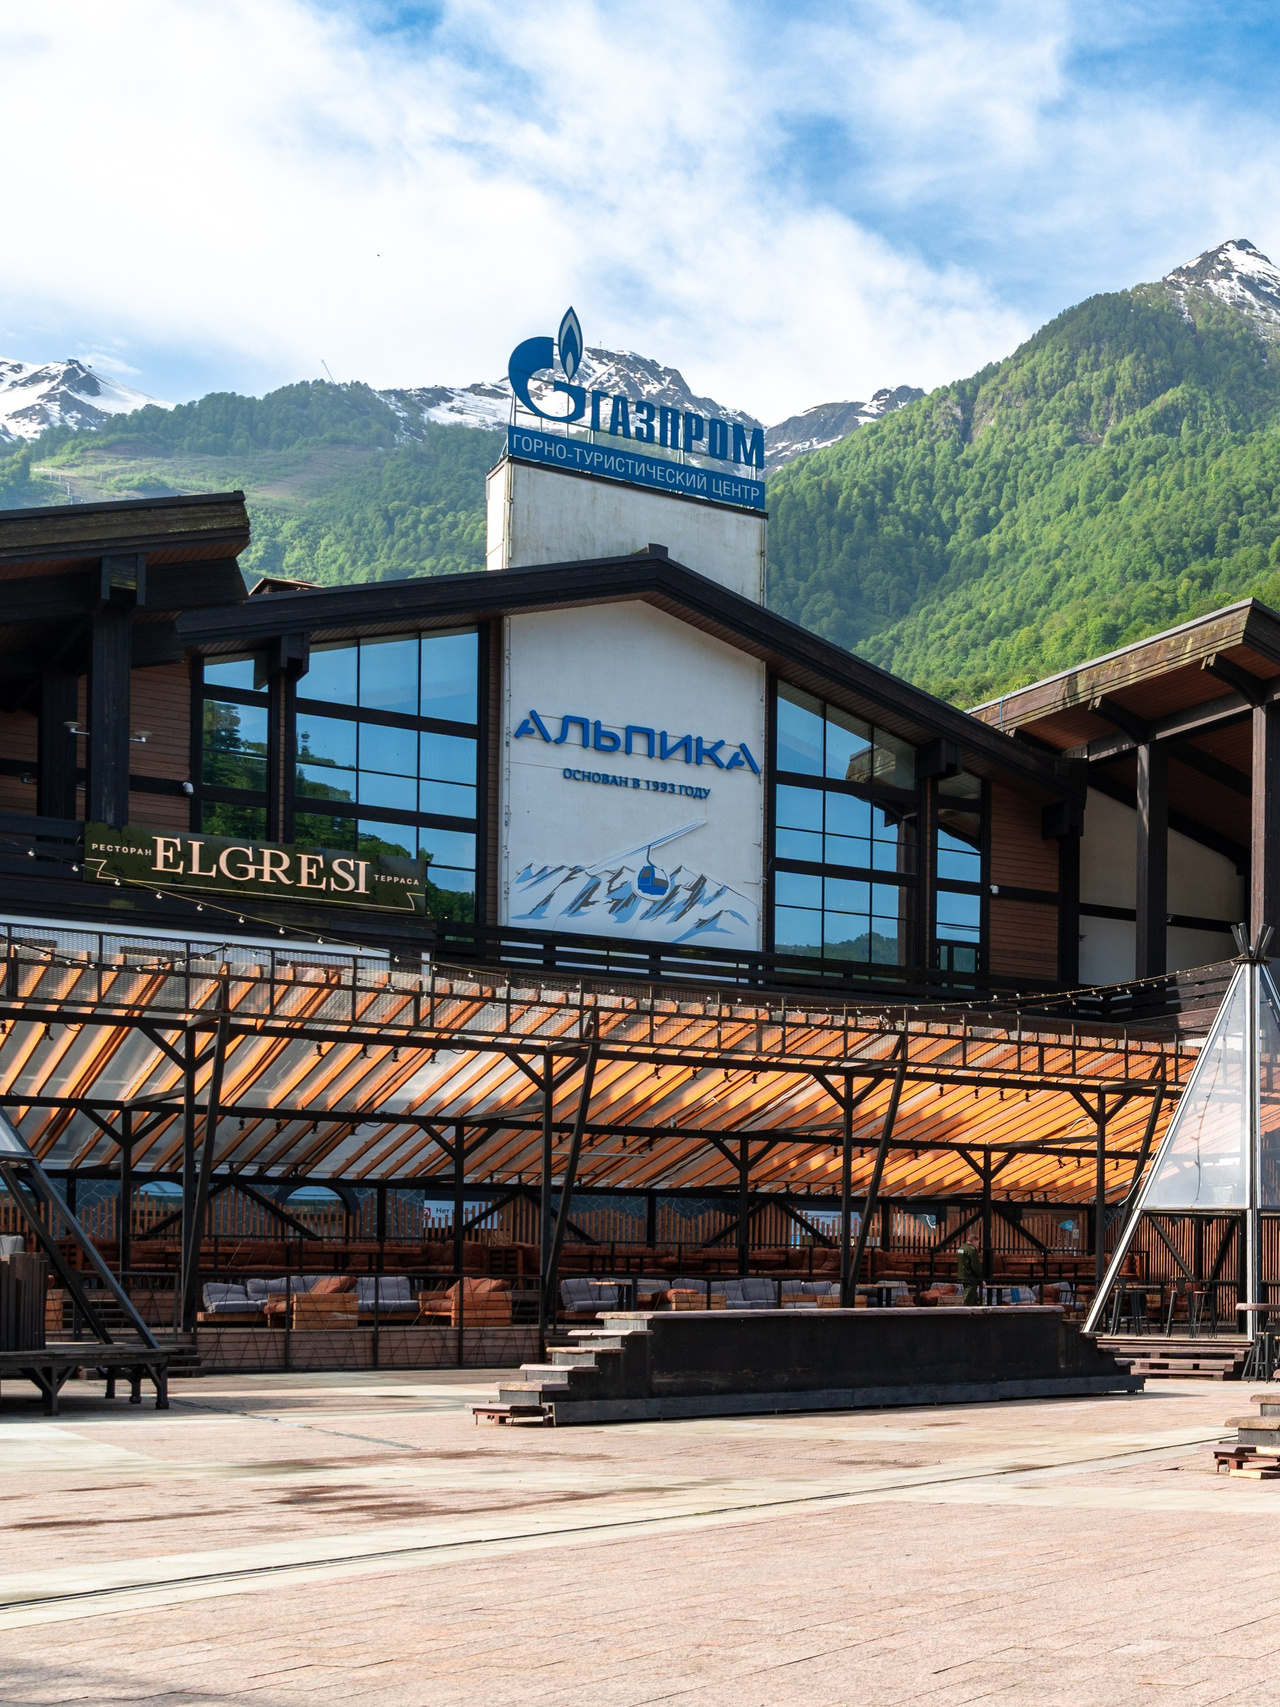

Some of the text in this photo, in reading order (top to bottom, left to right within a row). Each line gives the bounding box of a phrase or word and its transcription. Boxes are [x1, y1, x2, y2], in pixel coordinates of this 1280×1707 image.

[590, 389, 765, 469] ГАЗПРОМ
[512, 434, 760, 501] ГОРНО-ТУРИСТИЧЕСКИЙ ЦЕНТР
[514, 709, 760, 775] АЛЬПИКА
[562, 768, 711, 800] ОСНОВАН В 1993 ГОДУ
[91, 843, 152, 857] РЕСТОРАН
[151, 836, 371, 894] ELGRESI
[373, 874, 420, 886] ТЕРРАСА
